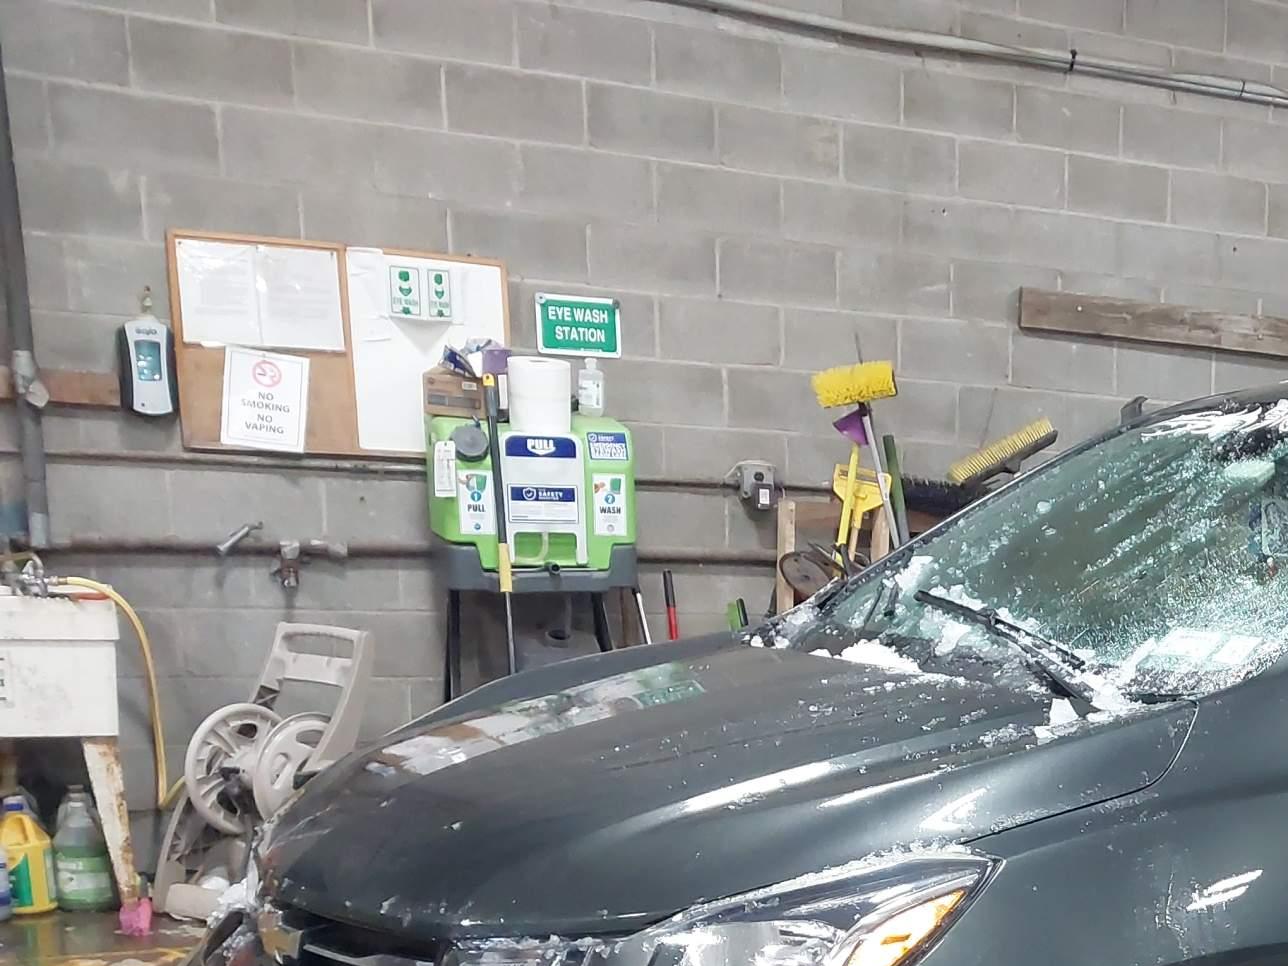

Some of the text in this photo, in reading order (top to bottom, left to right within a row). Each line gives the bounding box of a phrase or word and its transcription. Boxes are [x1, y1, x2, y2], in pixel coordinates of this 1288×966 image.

[548, 306, 609, 324] EYE WASH
[555, 326, 606, 342] STATION
[258, 391, 274, 401] NO
[240, 398, 291, 413] SMOKING
[256, 413, 273, 423] NO
[244, 421, 285, 434] VAPING
[527, 439, 555, 450] PULL
[467, 504, 485, 512] PULL
[600, 506, 621, 514] WASH
